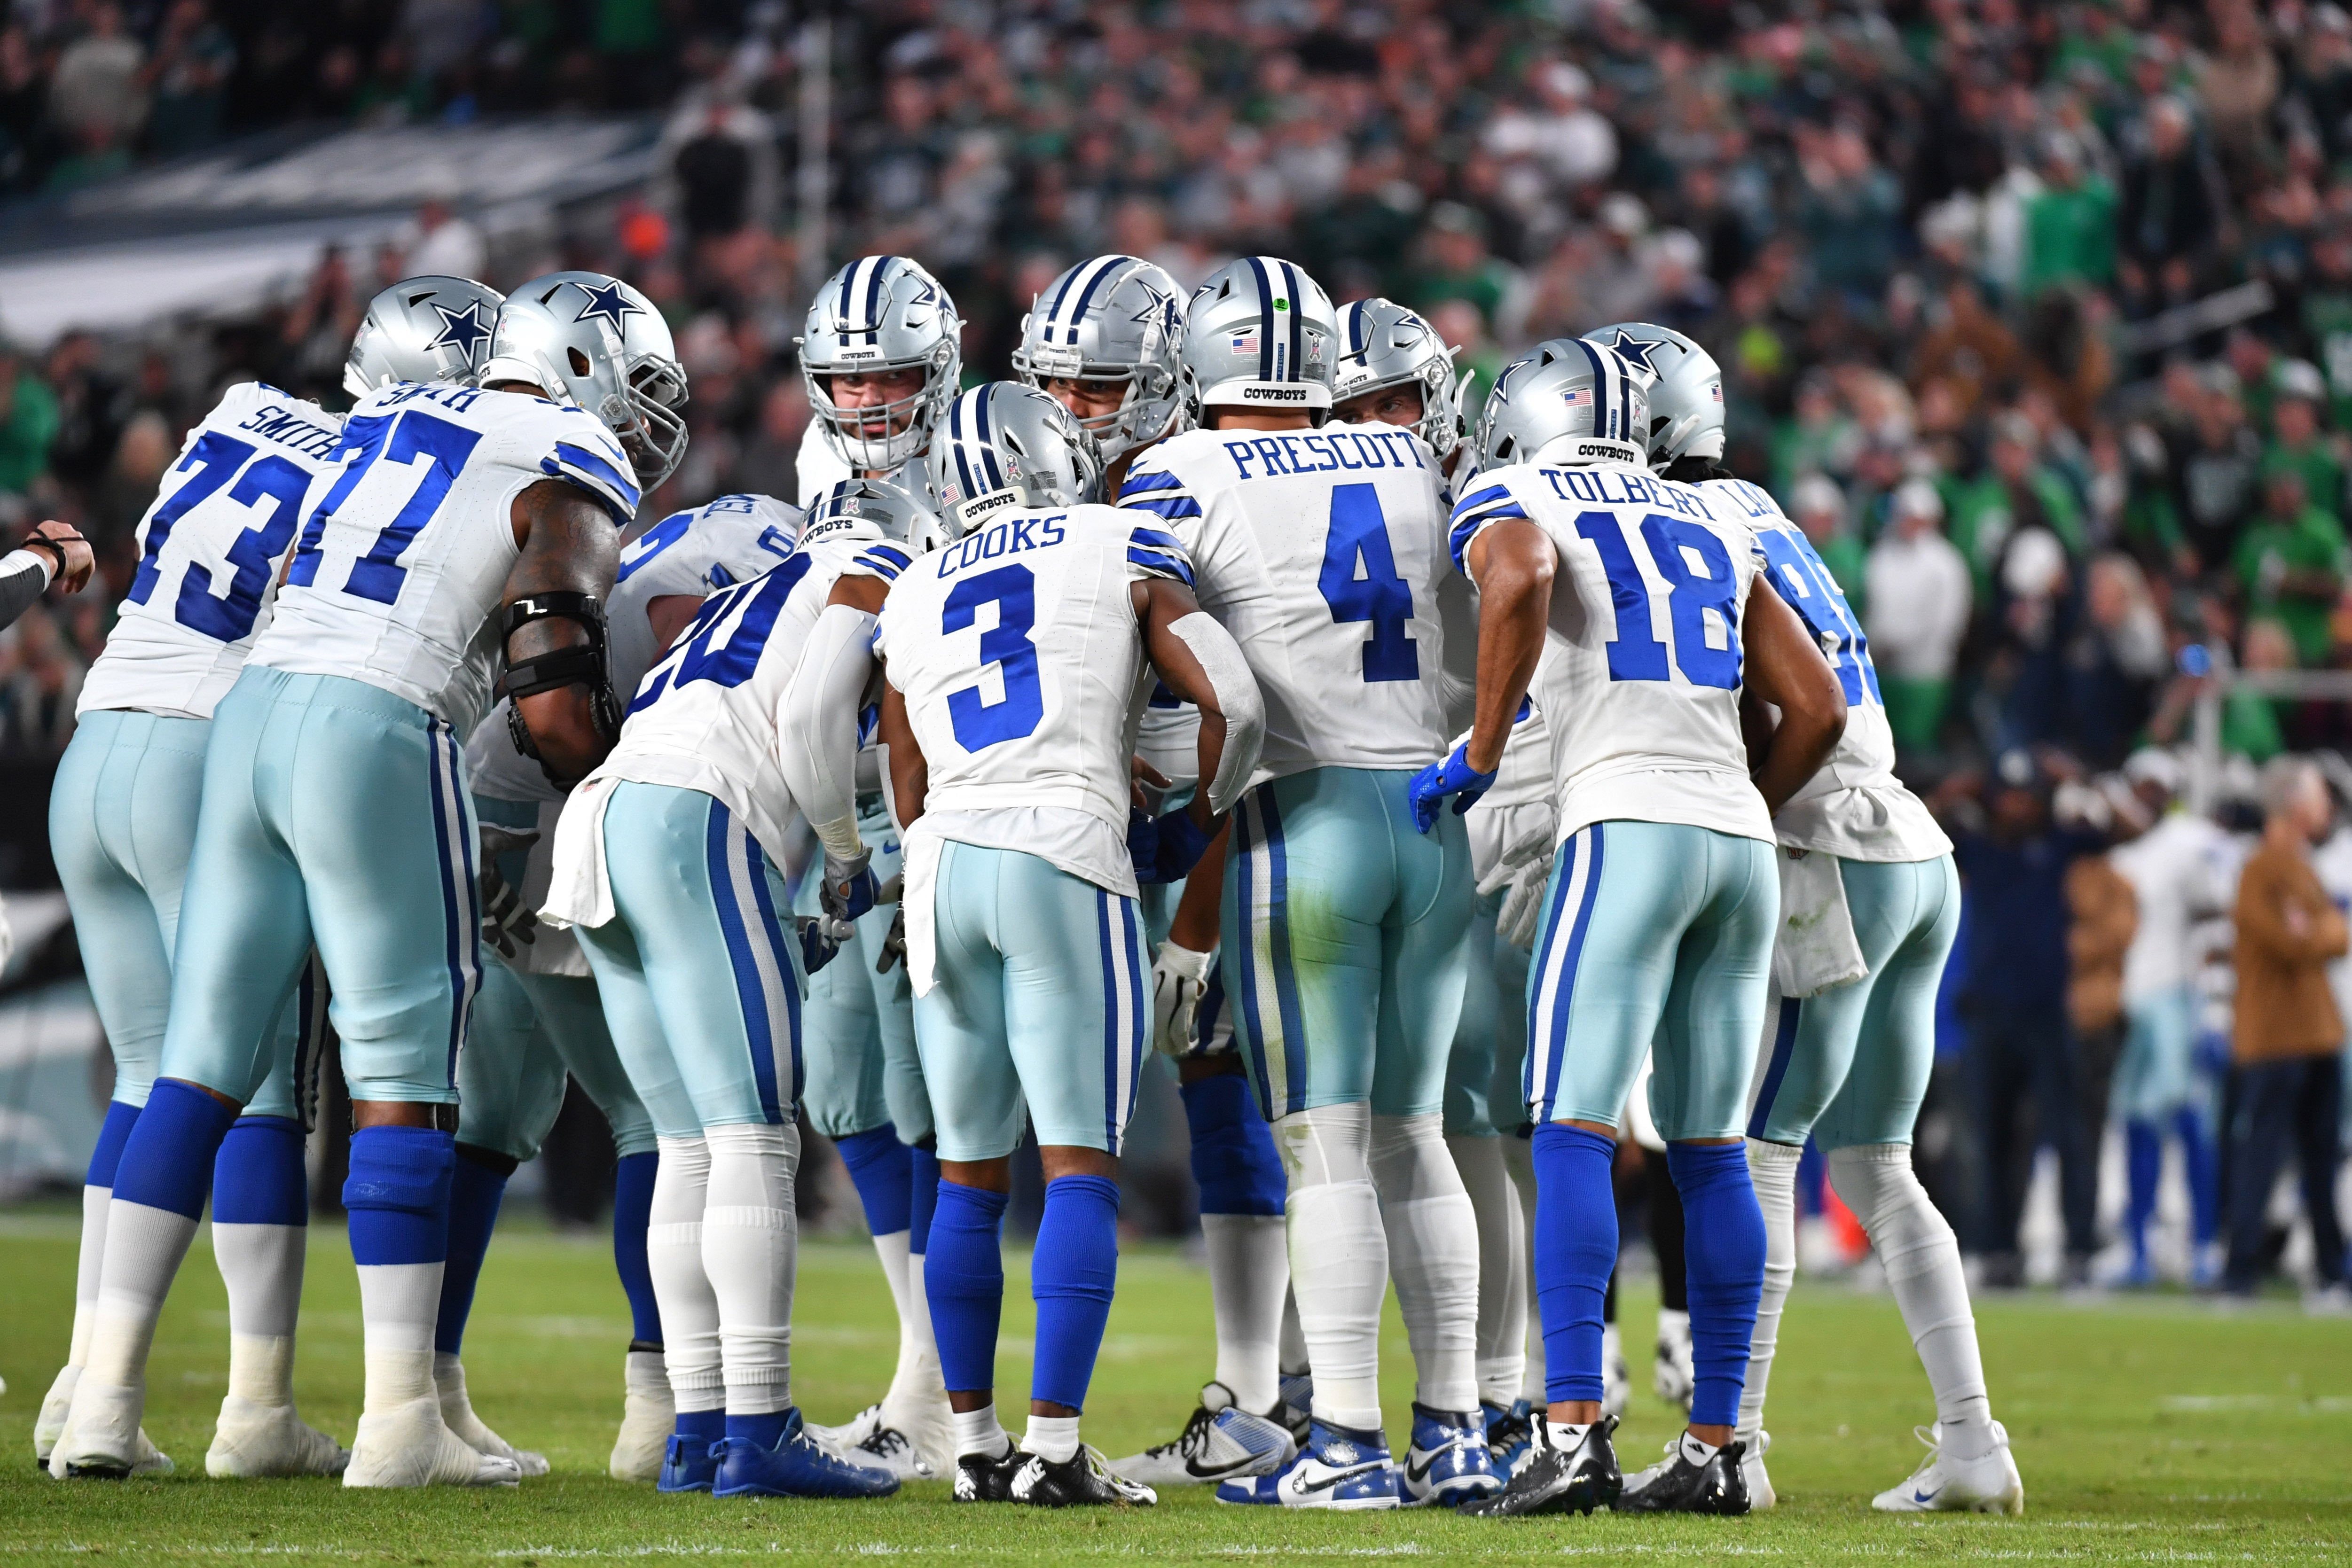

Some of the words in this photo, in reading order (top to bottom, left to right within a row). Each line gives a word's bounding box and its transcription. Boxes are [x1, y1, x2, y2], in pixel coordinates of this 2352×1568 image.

[841, 351, 875, 360] COWBOYS
[1243, 388, 1307, 401] COWBOYS
[238, 405, 343, 460] SMITH
[1223, 431, 1425, 480] PRESCOTT
[1578, 444, 1635, 463] COWBOYS
[973, 463, 983, 484] COOKS
[1538, 469, 1717, 522] TOLBERT
[286, 409, 483, 606] 77
[965, 492, 1016, 518] COWBOYS
[127, 430, 314, 643] 73
[937, 514, 1067, 579] COOKS
[1317, 482, 1419, 682] 4
[1575, 511, 1744, 692] 18
[623, 551, 813, 723] 20
[942, 563, 1044, 754] 3
[1011, 1454, 1047, 1498] NIKE
